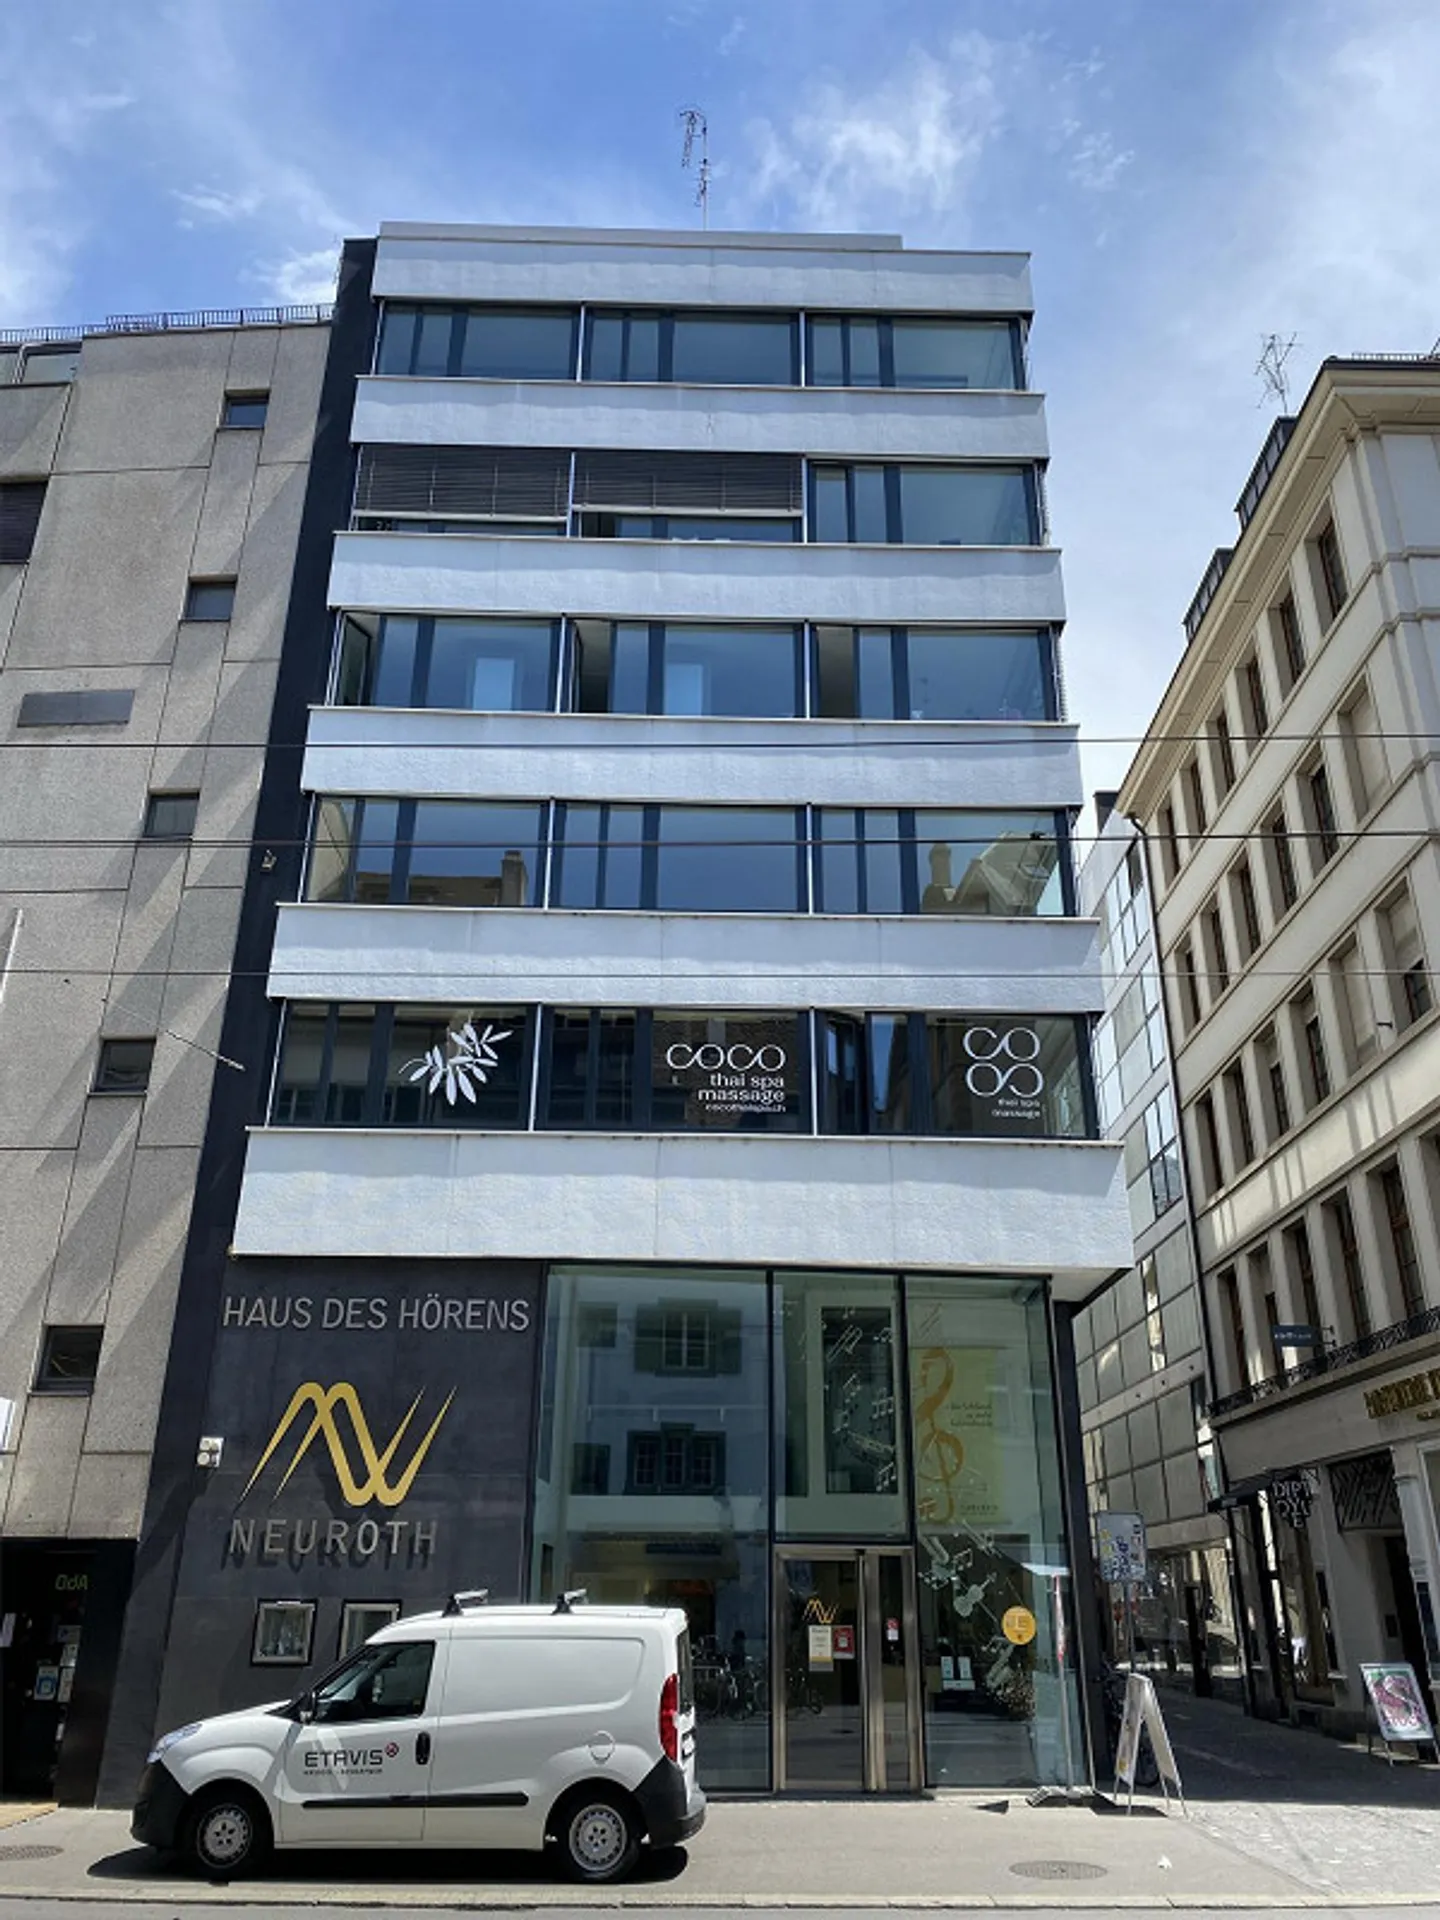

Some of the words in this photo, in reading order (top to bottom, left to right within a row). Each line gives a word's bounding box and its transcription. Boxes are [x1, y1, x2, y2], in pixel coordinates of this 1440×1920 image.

[710, 1072, 745, 1087] thai
[750, 1075, 784, 1091] spa
[698, 1089, 785, 1105] massage
[223, 1296, 313, 1329] HAUS
[322, 1298, 388, 1330] DES
[399, 1293, 530, 1331] HÖRENS
[229, 1519, 438, 1554] NEUROTH
[304, 1749, 384, 1767] ETAVIS
